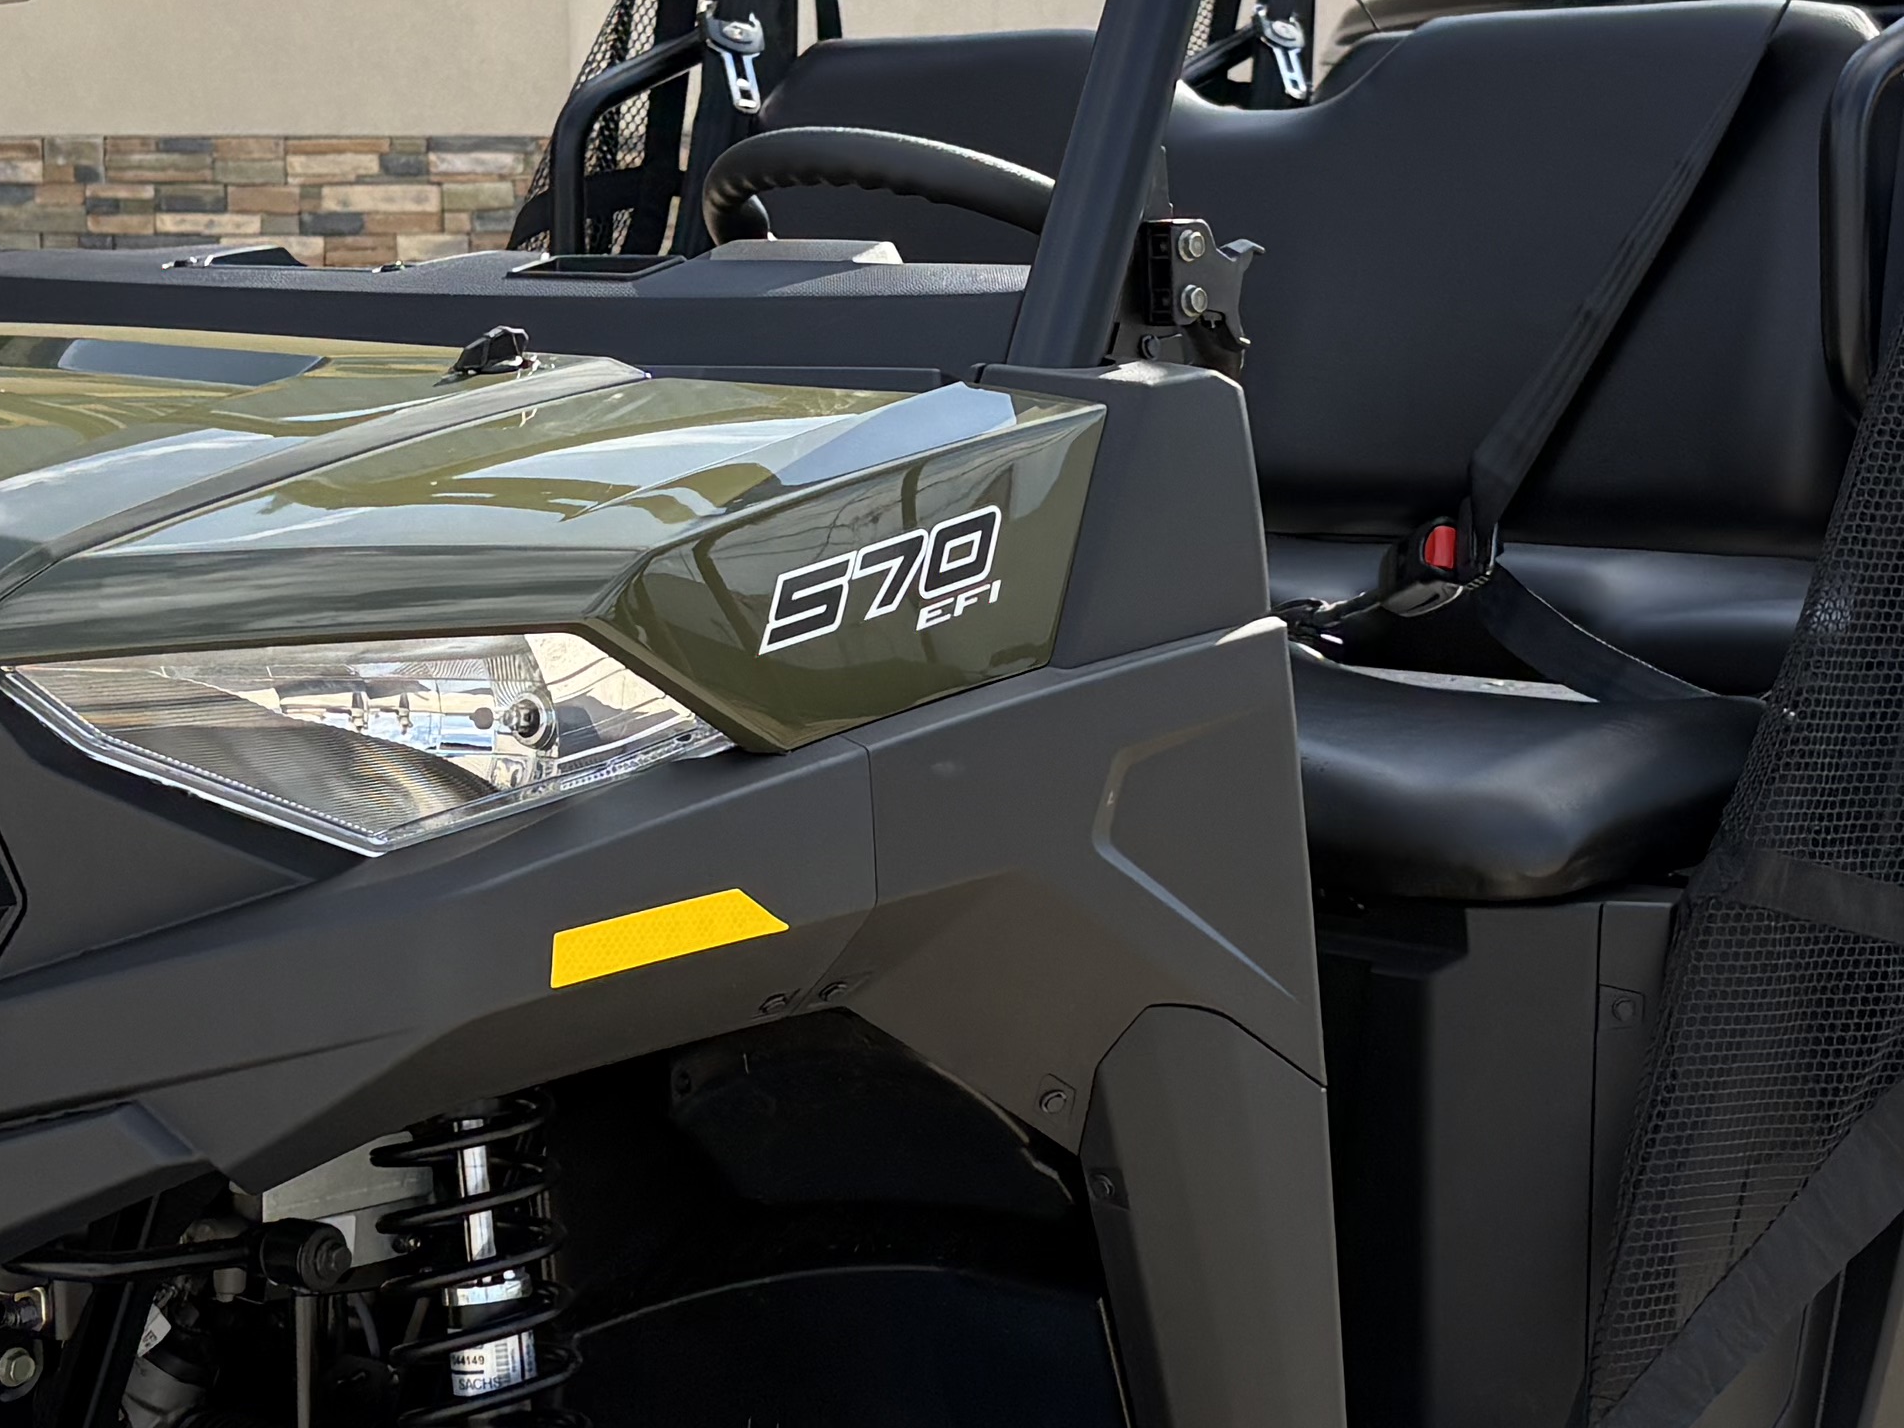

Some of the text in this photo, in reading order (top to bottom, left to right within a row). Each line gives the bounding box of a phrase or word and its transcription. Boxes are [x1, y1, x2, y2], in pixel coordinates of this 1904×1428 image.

[757, 504, 1002, 656] 570
[916, 579, 1001, 631] EFI
[458, 1376, 503, 1391] SACHS
